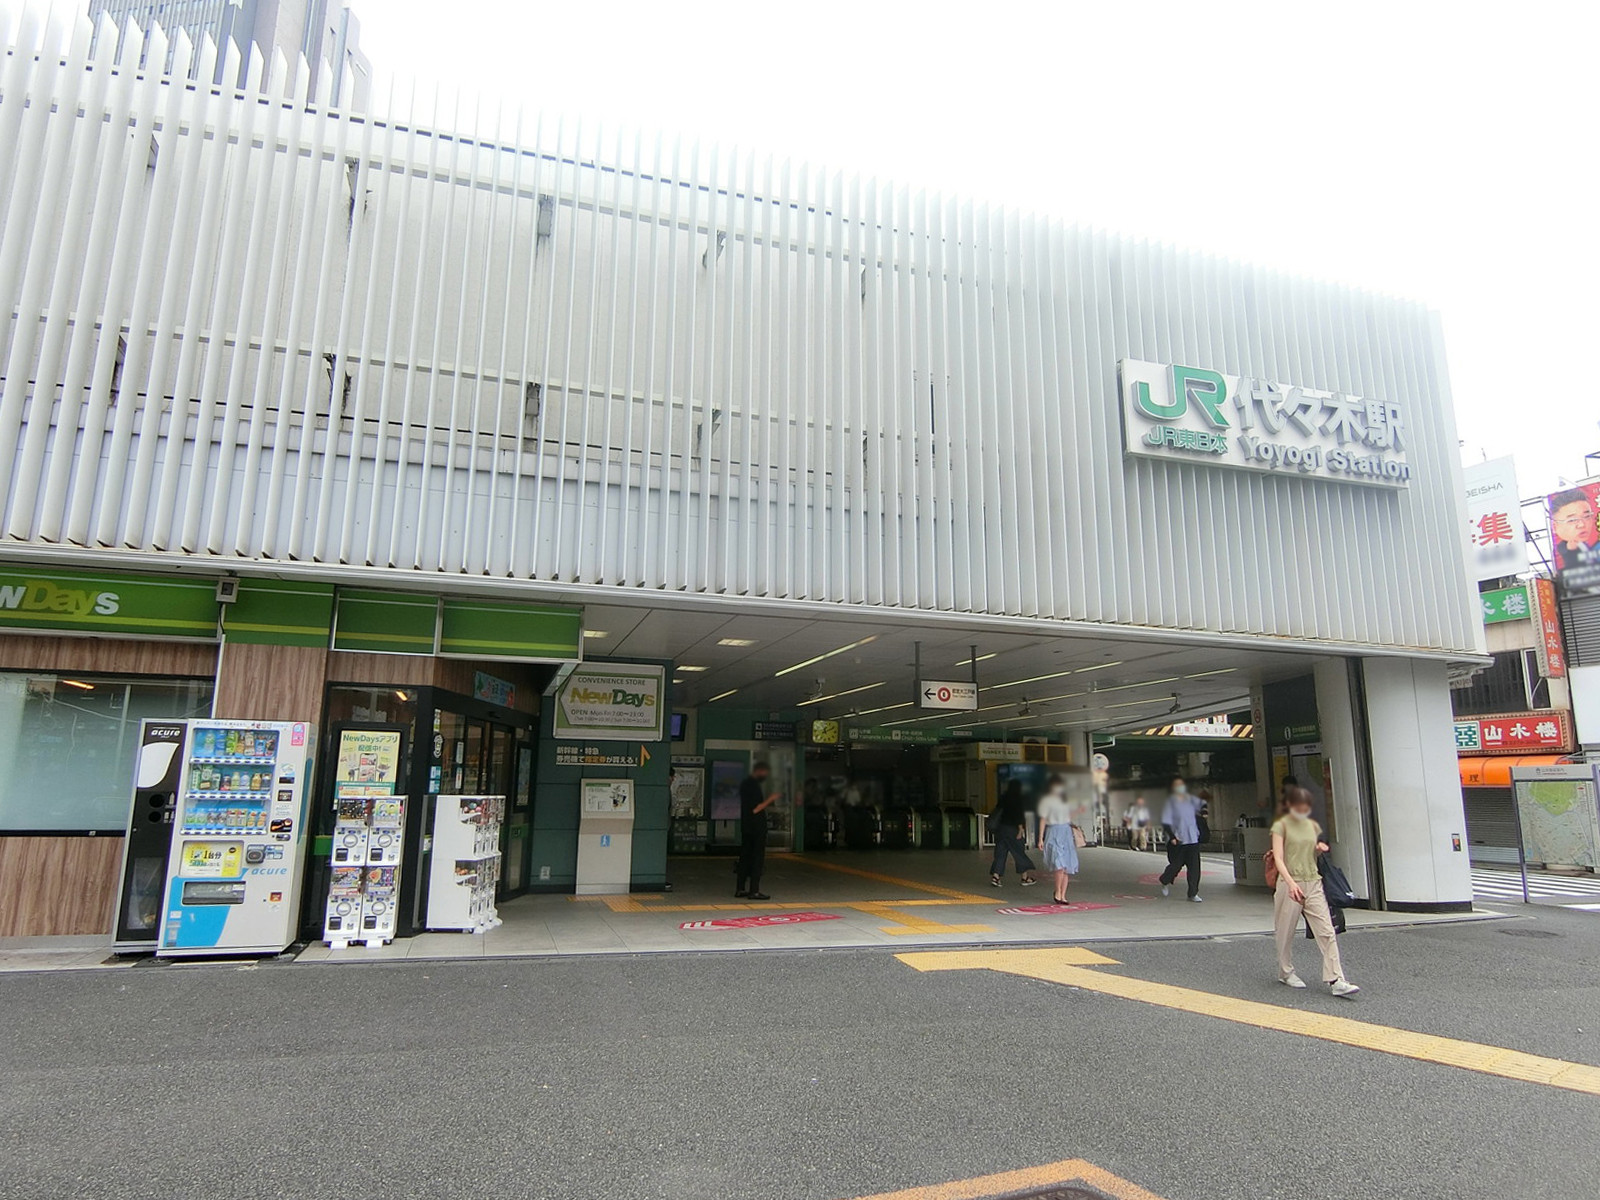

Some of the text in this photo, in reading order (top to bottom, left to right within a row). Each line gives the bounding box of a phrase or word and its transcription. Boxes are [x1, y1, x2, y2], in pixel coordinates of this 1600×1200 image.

[1135, 363, 1231, 429] JR
[1233, 376, 1409, 451] 代々木駅
[1145, 426, 1229, 455] JR東日本
[1238, 434, 1412, 482] Yoyogi Station
[1469, 512, 1514, 546] 集
[577, 676, 646, 686] CONVENIENCE STORE
[569, 687, 655, 707] NewDays
[151, 729, 181, 737] acure
[343, 733, 398, 745] NewDaysアプリ
[251, 866, 288, 876] acure
